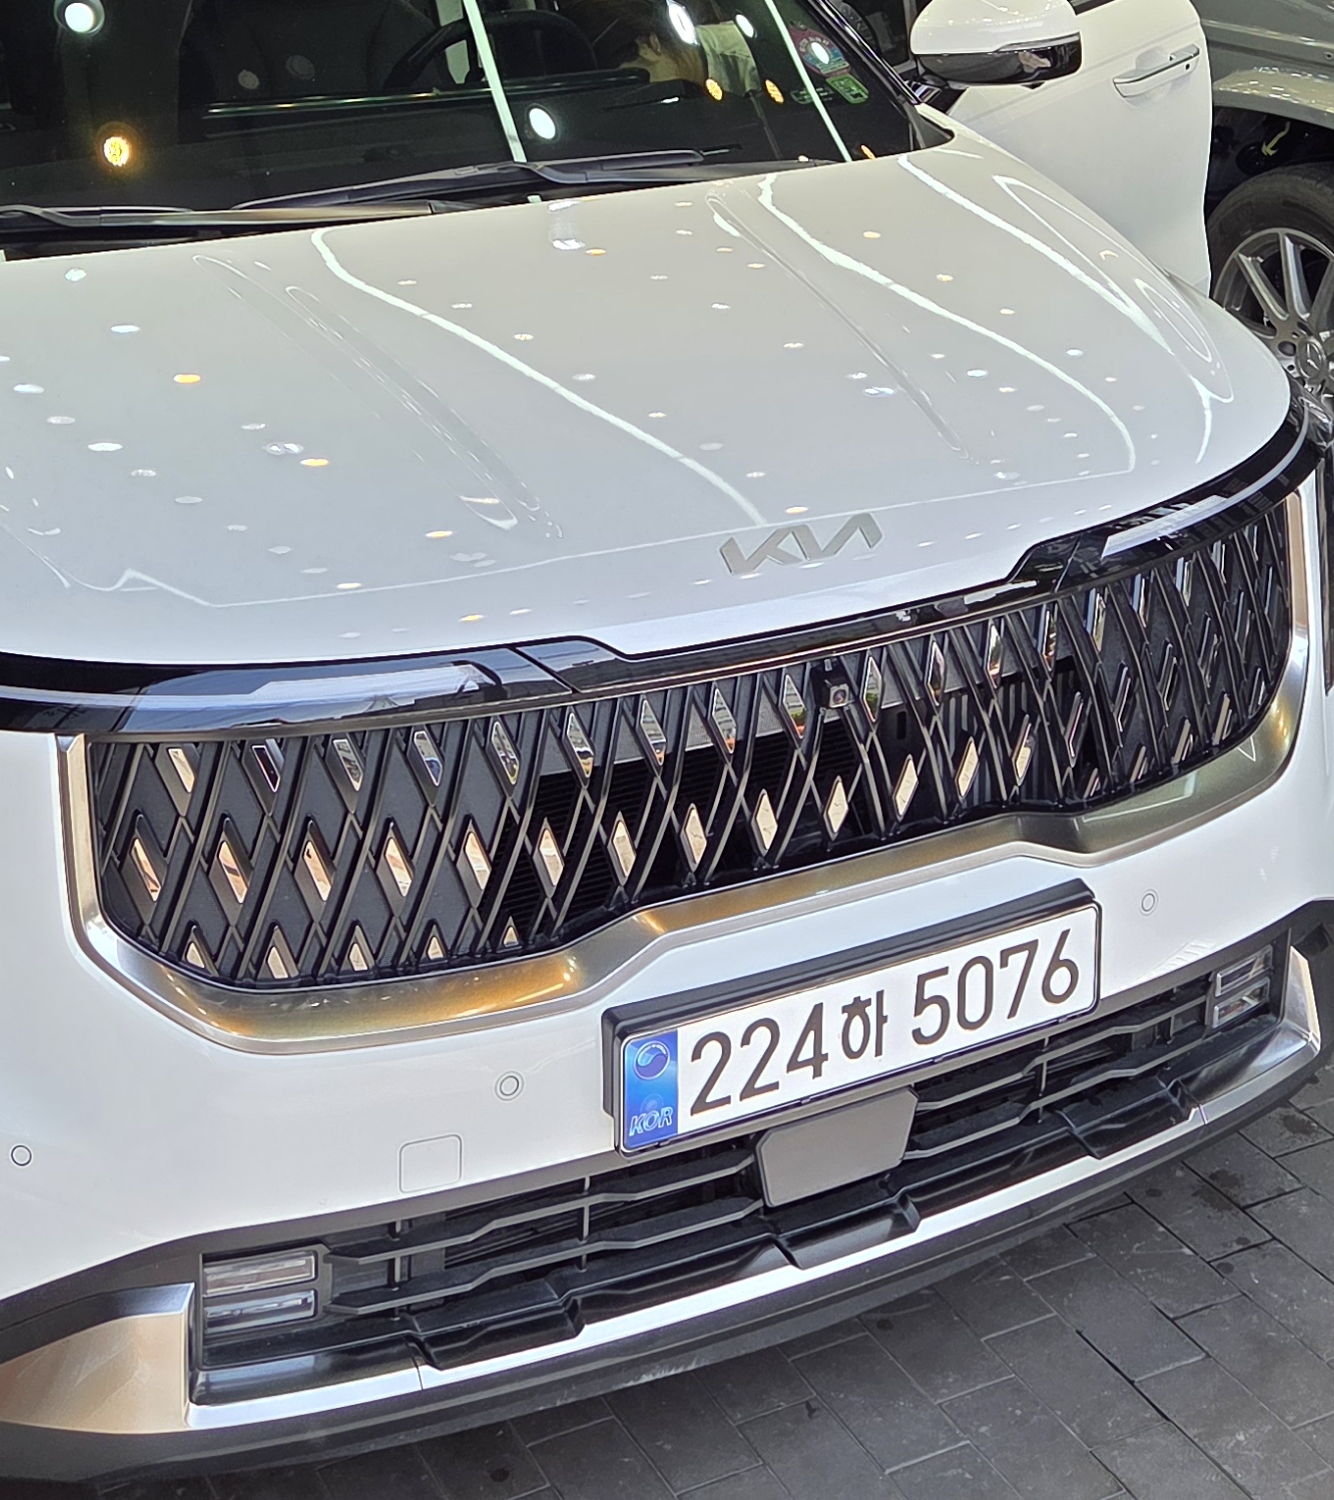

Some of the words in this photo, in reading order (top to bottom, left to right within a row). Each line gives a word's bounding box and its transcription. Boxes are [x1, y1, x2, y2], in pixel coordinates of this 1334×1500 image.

[719, 512, 883, 575] KIA
[690, 990, 889, 1117] 224하
[911, 928, 1080, 1046] 5076
[628, 1106, 674, 1136] KOR
